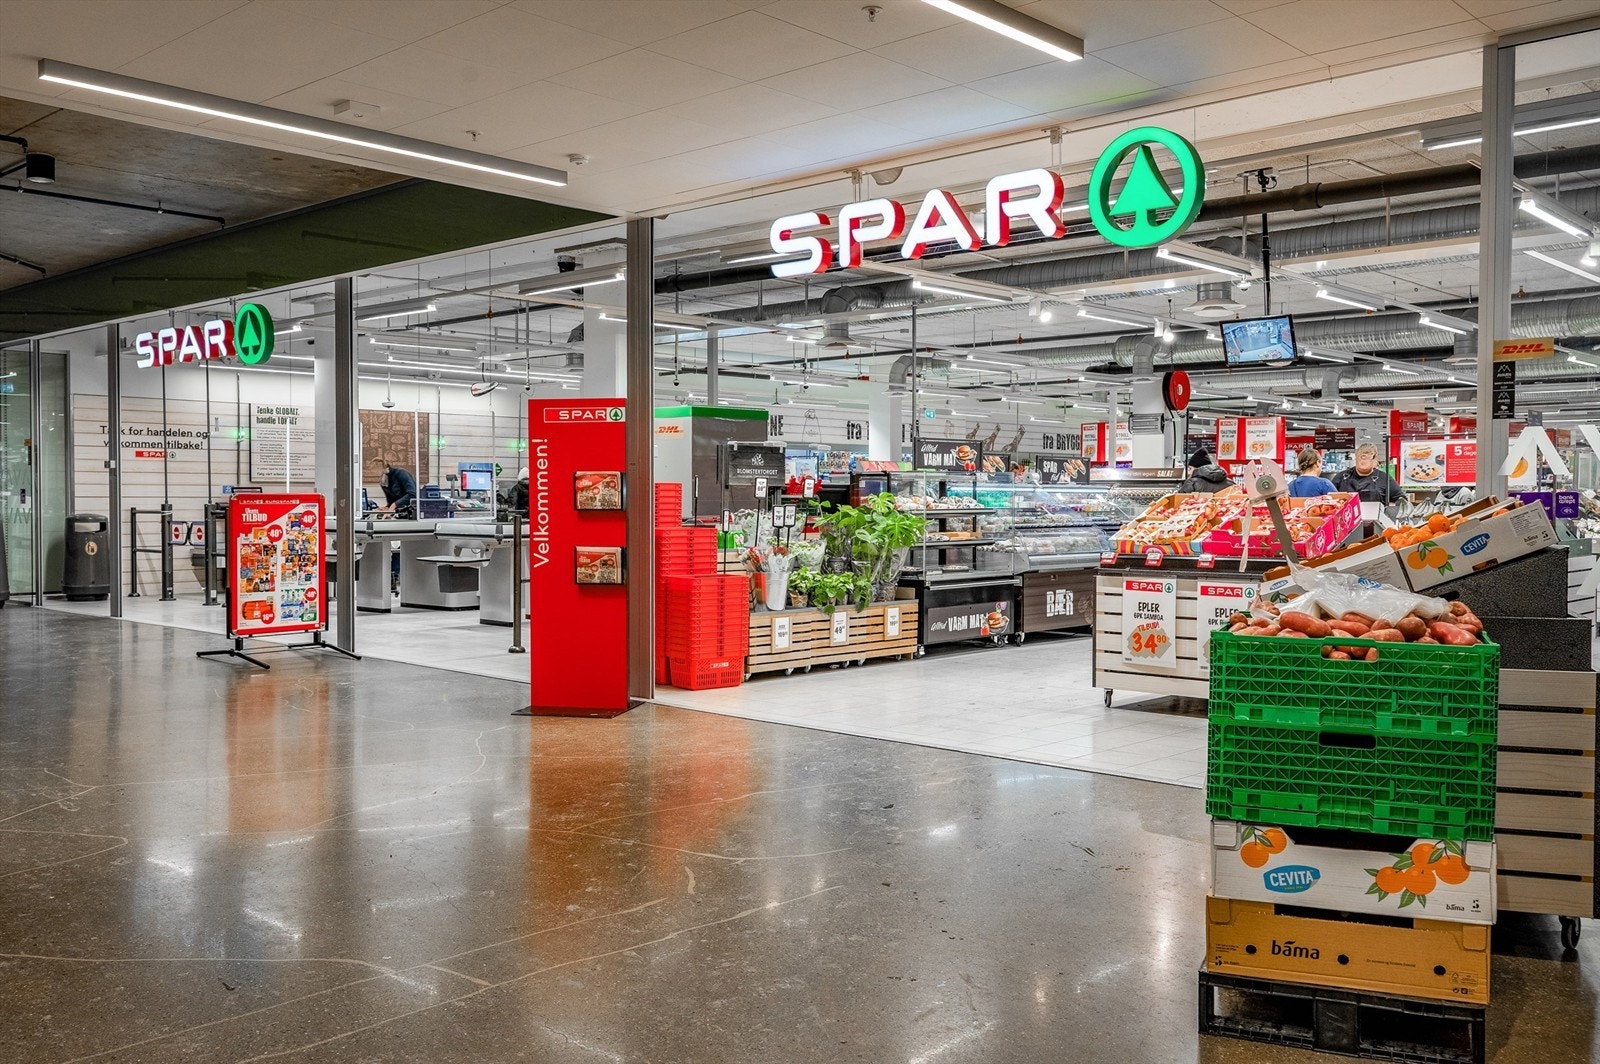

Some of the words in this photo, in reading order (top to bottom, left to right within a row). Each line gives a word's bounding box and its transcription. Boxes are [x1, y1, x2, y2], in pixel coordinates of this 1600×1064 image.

[769, 168, 1066, 279] SPAR
[135, 318, 236, 369] SPAR
[1502, 343, 1545, 354] DHL
[256, 416, 277, 425] handle
[559, 410, 606, 420] SPAR
[128, 426, 144, 435] for
[146, 427, 193, 437] handelen
[195, 430, 208, 439] og
[846, 420, 862, 440] fra
[166, 440, 204, 450] tilbake!
[1042, 433, 1054, 450] fra
[1454, 446, 1463, 456] 5
[923, 453, 942, 466] VARM
[943, 454, 956, 466] MAT
[1042, 460, 1058, 472] SPAR
[531, 438, 549, 568] Velkommen!
[242, 513, 268, 522] TILBUD
[1463, 535, 1488, 553] CEVITA
[1132, 582, 1162, 591] SPAR
[1207, 587, 1242, 596] SPAR
[1046, 588, 1074, 617] BÆR
[1138, 602, 1160, 613] EPLER
[947, 615, 968, 632] VARM
[969, 613, 984, 629] MAT
[1269, 870, 1314, 887] CEVITA
